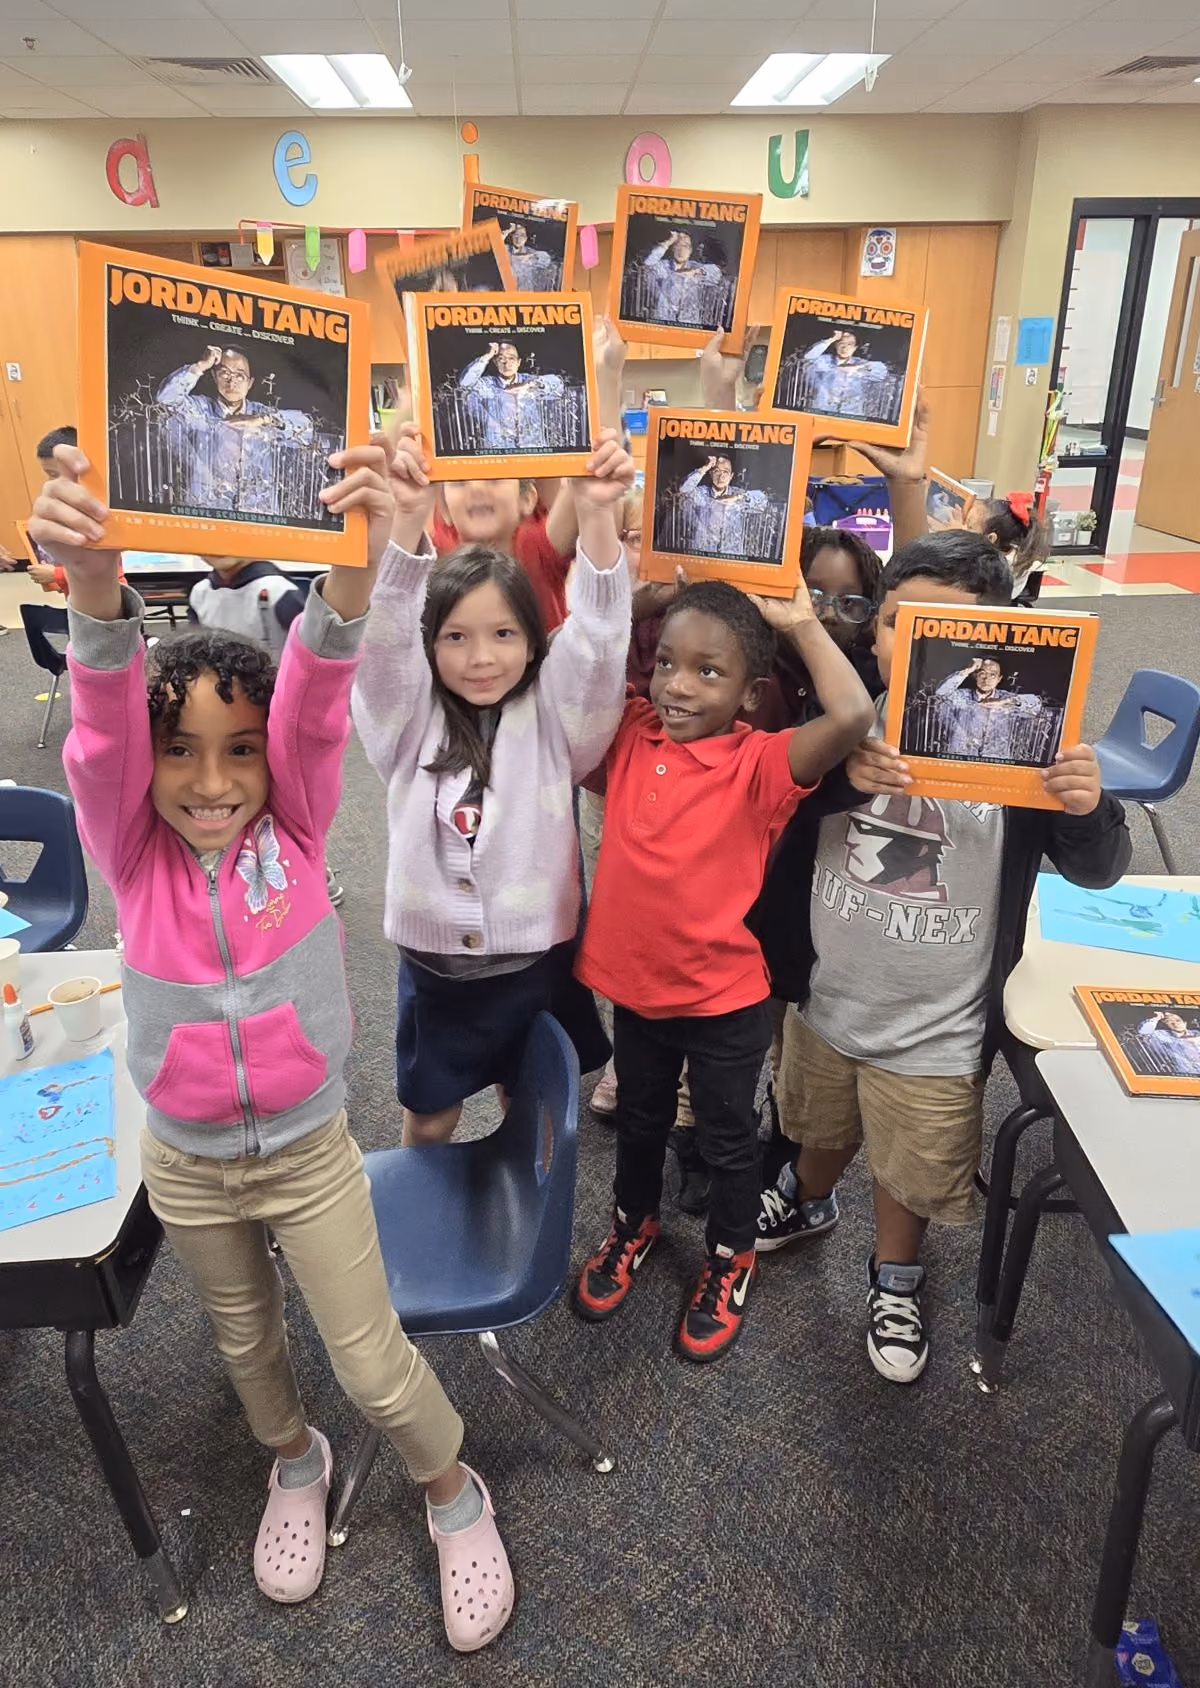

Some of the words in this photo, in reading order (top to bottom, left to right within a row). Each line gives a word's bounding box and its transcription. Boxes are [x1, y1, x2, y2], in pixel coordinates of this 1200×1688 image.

[106, 132, 159, 208] a
[272, 129, 318, 207] e
[461, 120, 480, 183] i
[625, 131, 672, 186] o
[768, 129, 809, 198] u
[475, 192, 529, 213] JORDAN
[629, 196, 697, 218] JORDAN
[698, 202, 747, 222] TANG
[109, 268, 253, 325] JORDAN
[258, 299, 348, 344] TANG
[427, 306, 517, 331] JORDAN
[519, 304, 581, 325] TANG
[789, 297, 862, 320] JORDAN
[863, 307, 914, 328] TANG
[171, 313, 200, 328] THINK
[209, 321, 244, 336] CREATE
[252, 329, 295, 345] DISCOVER
[660, 419, 737, 441] JORDAN
[739, 425, 795, 445] TANG
[170, 506, 212, 518] CHERYL
[215, 510, 288, 525] SCHUERMANN
[914, 618, 1009, 643] JORDAN
[1012, 625, 1078, 648] TANG
[1093, 992, 1173, 1004] JORDAN
